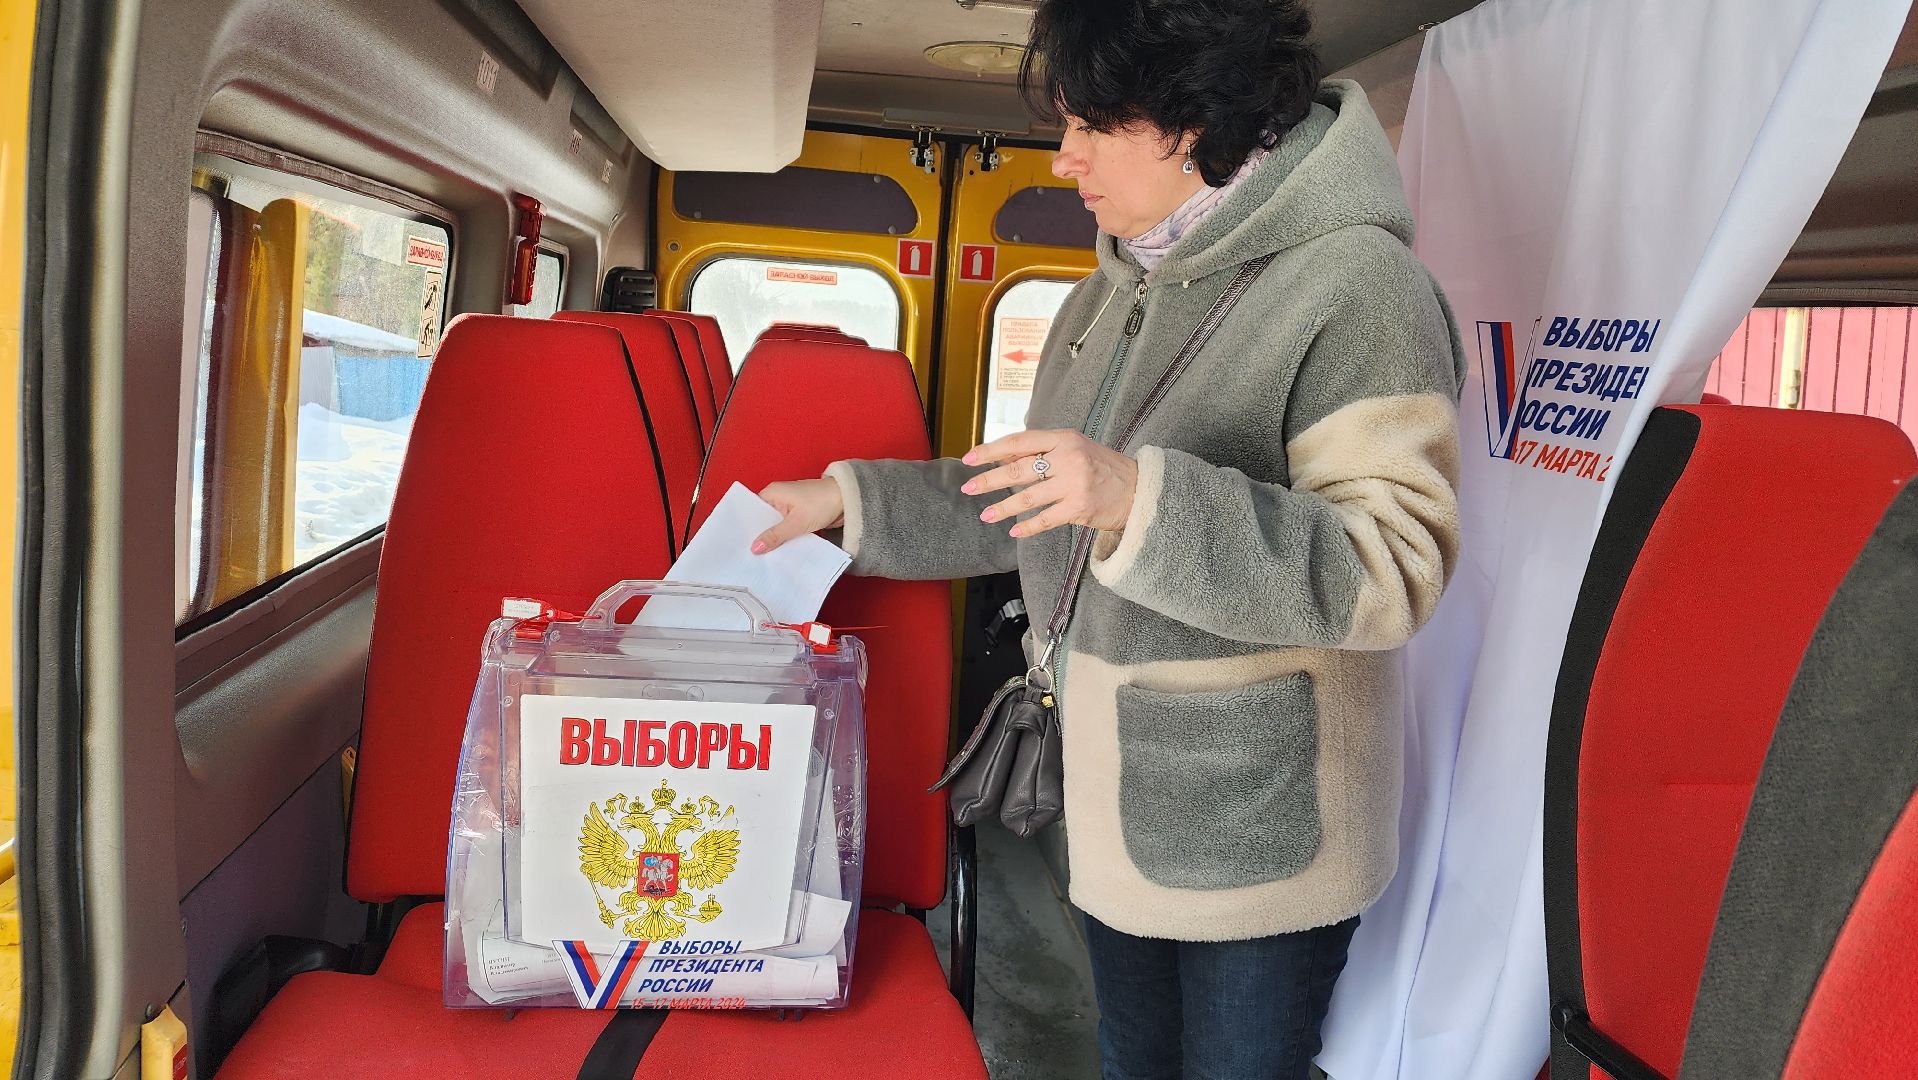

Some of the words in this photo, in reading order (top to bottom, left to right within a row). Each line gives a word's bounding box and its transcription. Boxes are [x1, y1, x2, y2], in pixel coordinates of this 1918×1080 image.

[1542, 316, 1661, 353] ВЫБОРЫ
[1520, 398, 1612, 441] ОССИИ
[1532, 443, 1601, 480] МАРТА
[559, 716, 772, 771] ВЫБОРЫ
[658, 940, 742, 955] ВЫБОРЫ
[648, 958, 765, 975] ПРЕЗИДЕНТА
[638, 978, 714, 993] РОССИИ
[667, 997, 713, 1010] МАРТА
[713, 997, 746, 1010] 2024
